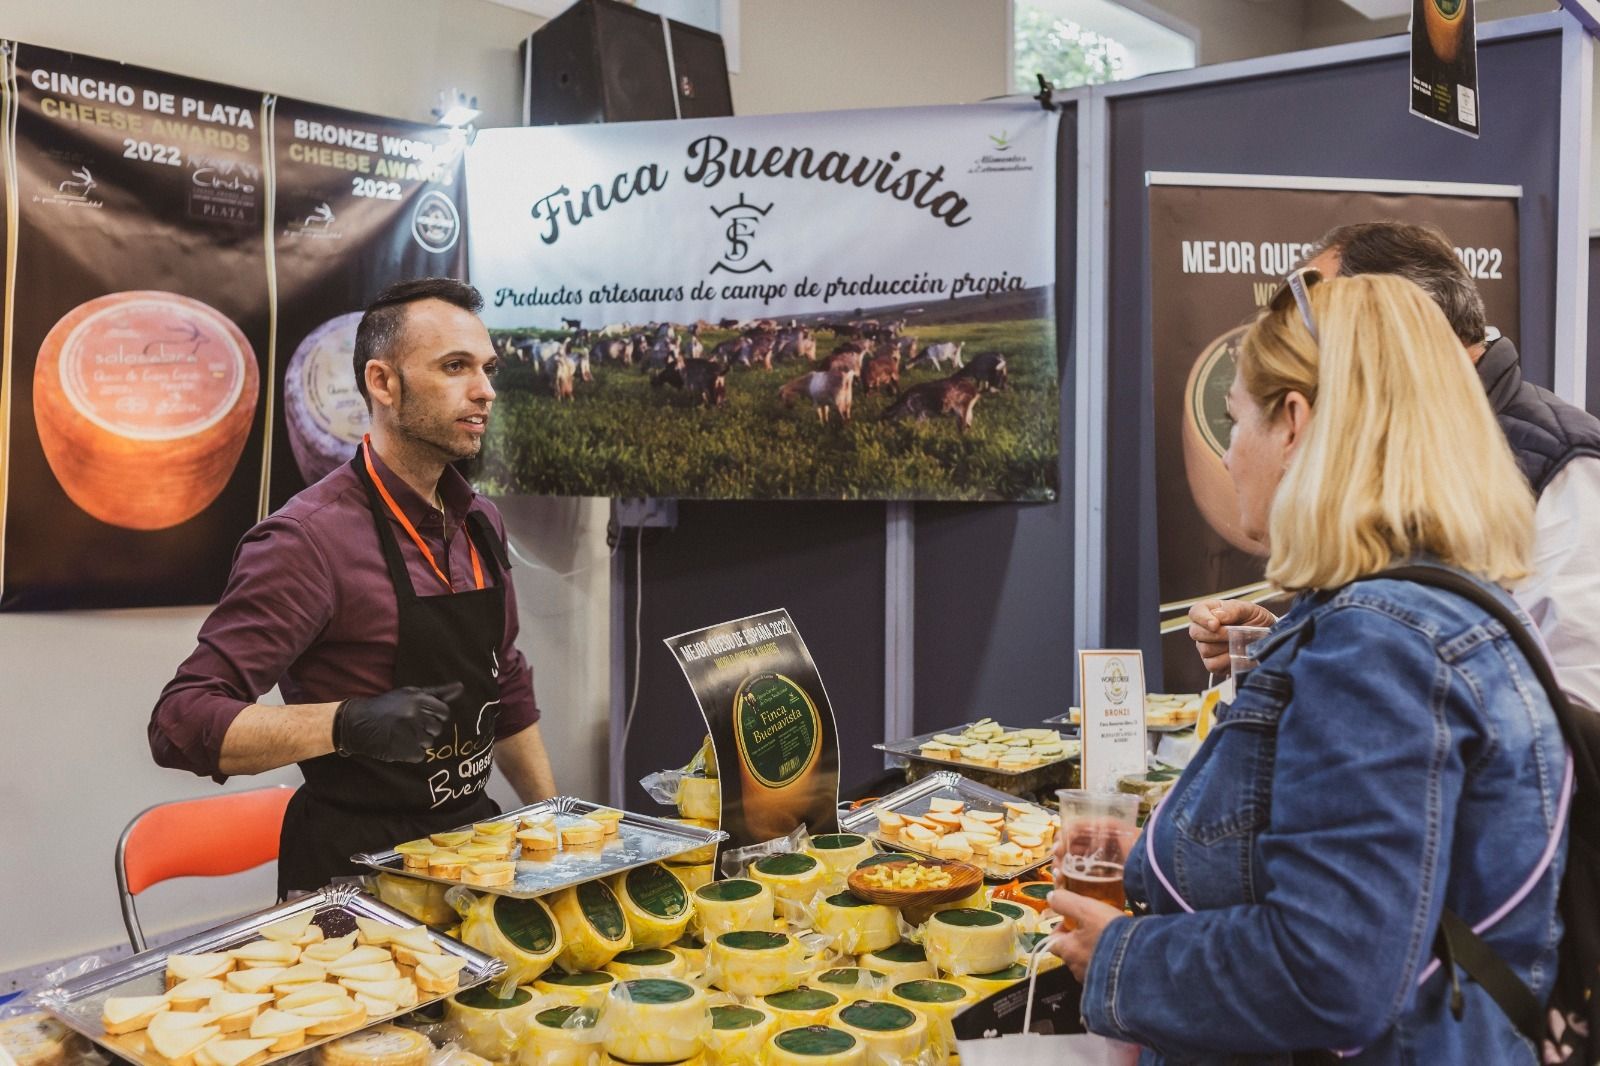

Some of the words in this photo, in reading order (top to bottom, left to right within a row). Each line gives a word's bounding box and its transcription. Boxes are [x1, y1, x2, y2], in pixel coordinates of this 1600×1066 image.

[31, 69, 135, 107] CINCHO
[143, 90, 176, 115] DE
[182, 97, 255, 130] PLATA
[40, 97, 142, 134] CHEESE
[151, 119, 251, 153] AWARDS
[294, 118, 379, 152] BRONZE
[123, 138, 182, 167] 2022
[289, 143, 371, 174] CHEESE
[352, 176, 403, 200] 2022
[531, 163, 669, 245] Finca
[684, 134, 972, 228] Buenavista
[203, 203, 245, 220] PLATA
[1181, 240, 1256, 275] MEJOR
[494, 284, 583, 308] Productos
[588, 282, 684, 304] artesanos
[690, 279, 717, 301] de
[721, 283, 788, 306] campo
[794, 275, 821, 298] de
[823, 272, 948, 304] producción
[951, 271, 1026, 300] propia
[679, 640, 712, 663] MEJOR
[708, 633, 736, 655] QUESO
[732, 631, 747, 648] DE
[742, 623, 774, 645] ESPAÑA
[769, 616, 794, 638] 2022
[752, 708, 803, 744] Buenavista
[760, 704, 788, 726] Finca
